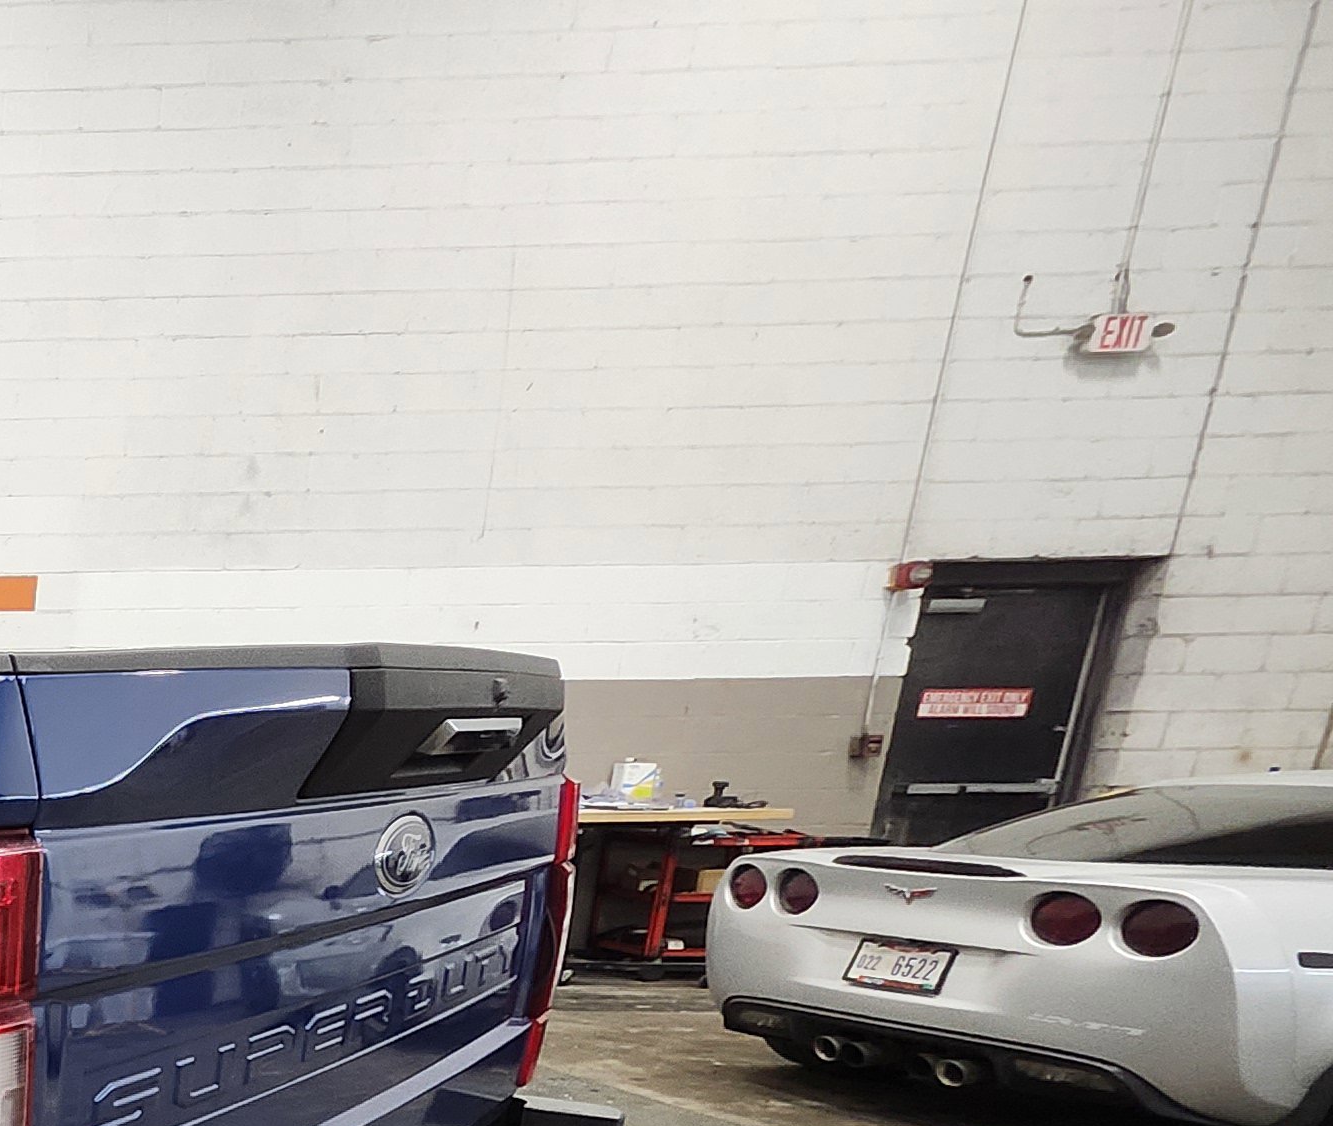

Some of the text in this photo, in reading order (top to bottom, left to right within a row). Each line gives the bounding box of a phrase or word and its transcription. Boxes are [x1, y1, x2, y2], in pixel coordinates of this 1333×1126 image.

[1099, 315, 1149, 349] EXIT
[981, 691, 1002, 703] EXIT
[1004, 691, 1030, 703] ONLY
[403, 942, 511, 1021] DUTY
[890, 955, 939, 981] 6522
